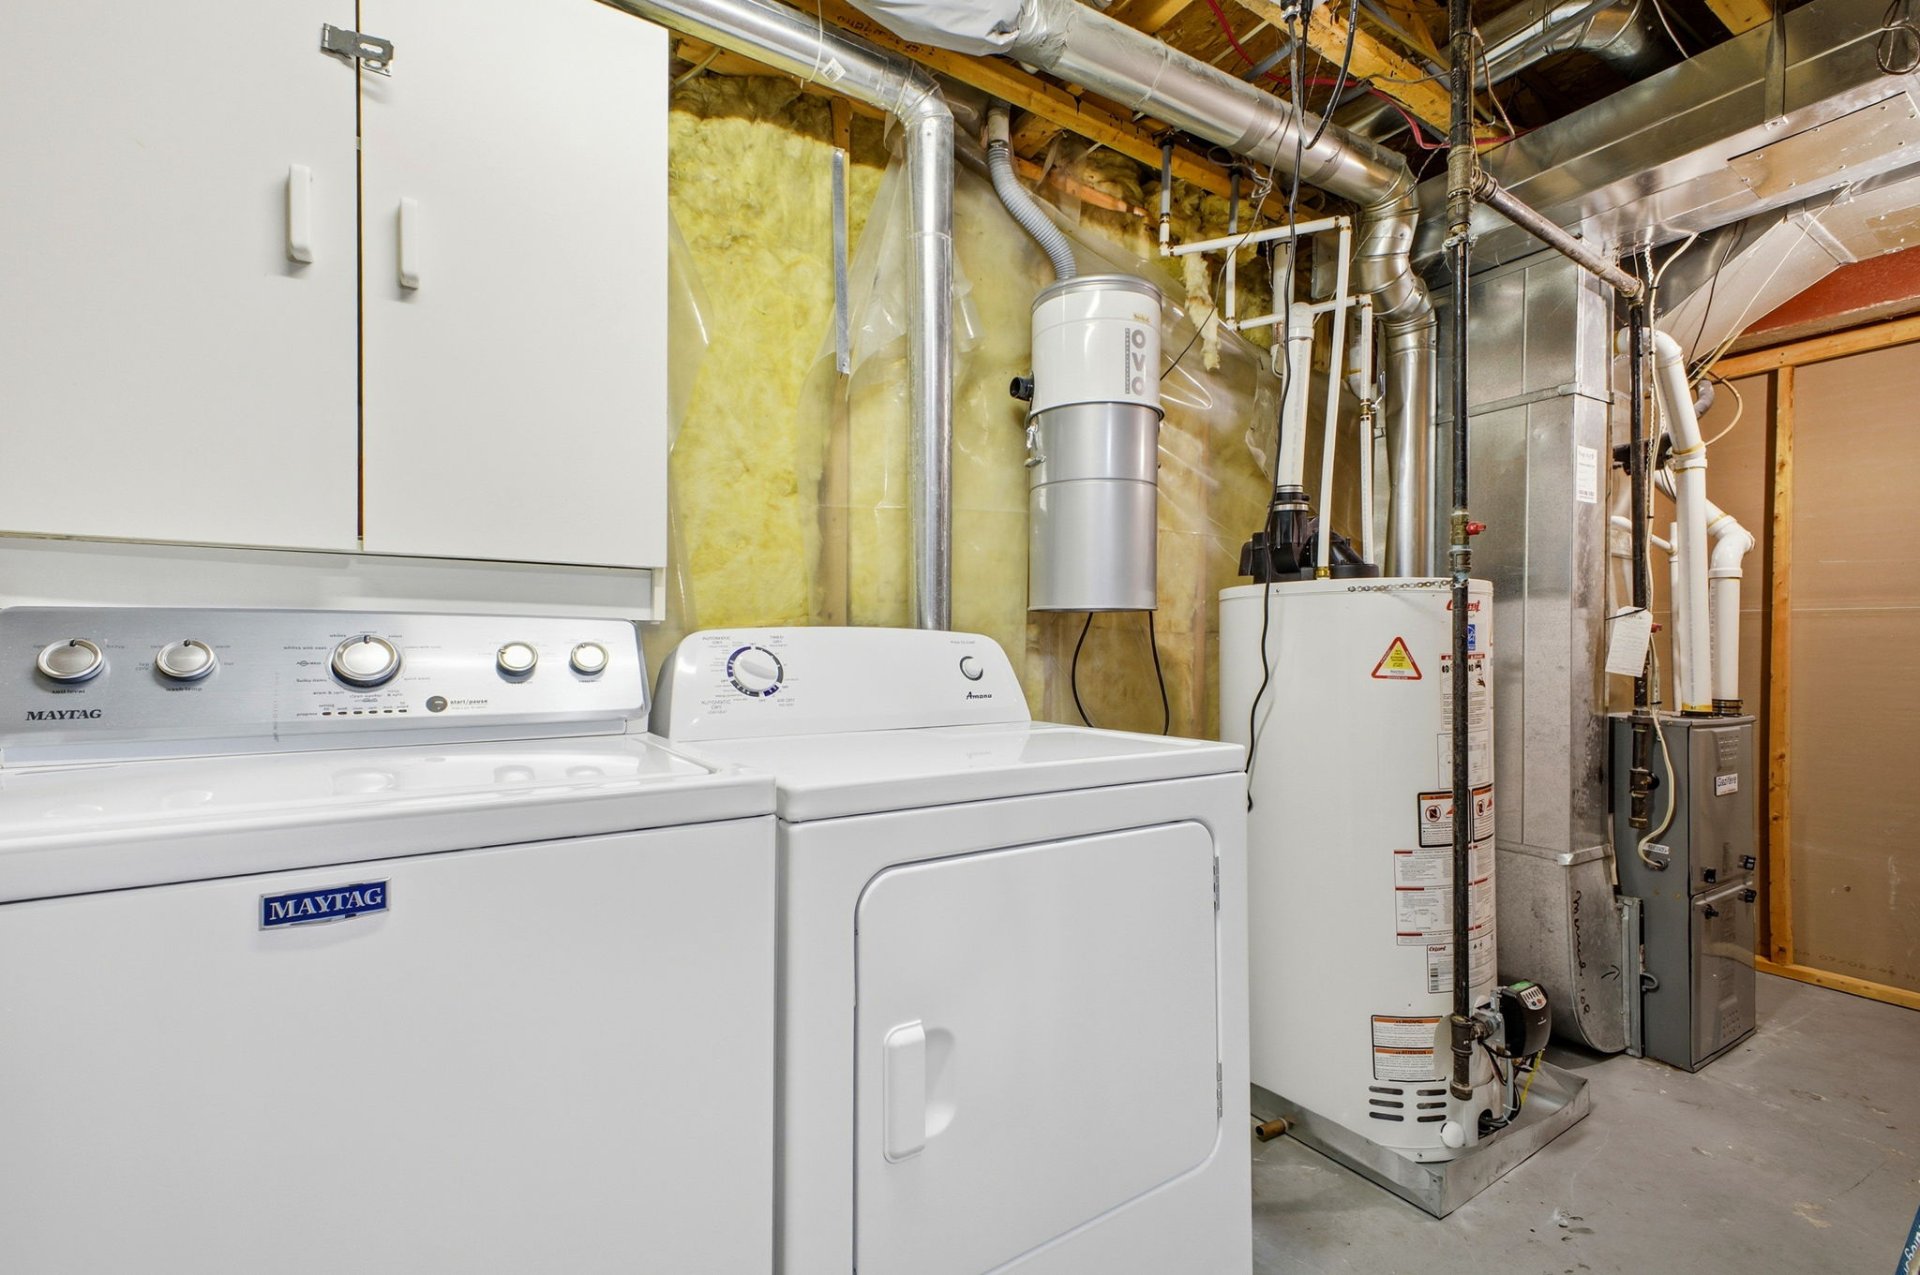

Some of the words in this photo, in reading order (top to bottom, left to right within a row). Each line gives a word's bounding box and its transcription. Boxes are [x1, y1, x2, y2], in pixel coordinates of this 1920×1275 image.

[1131, 329, 1146, 396] OVO
[966, 691, 992, 700] Amana
[25, 709, 102, 721] MAYTAG
[269, 887, 383, 920] MAYTAG
